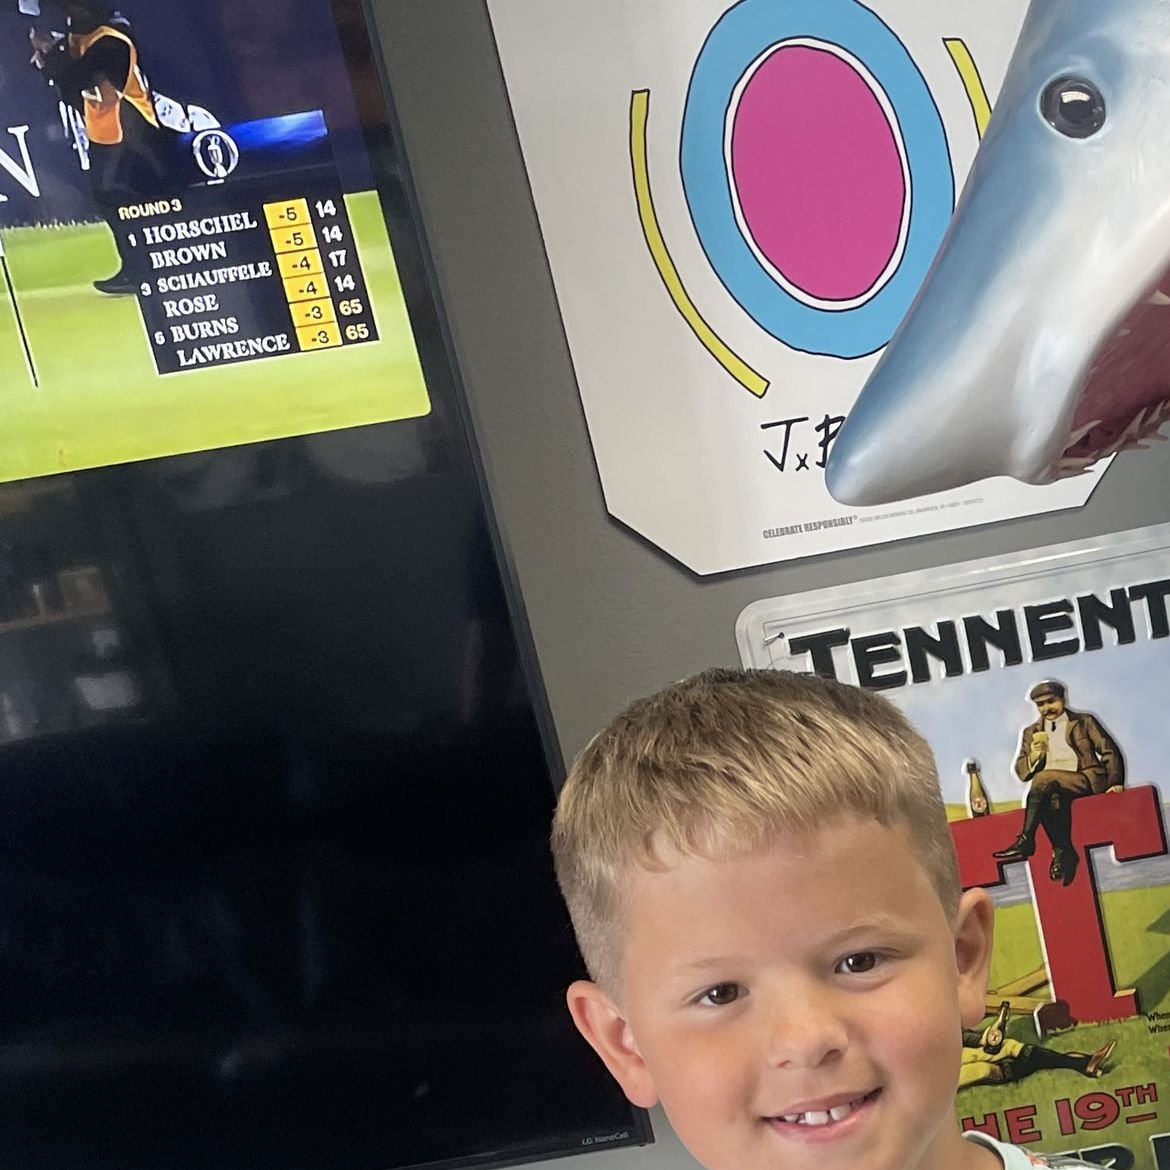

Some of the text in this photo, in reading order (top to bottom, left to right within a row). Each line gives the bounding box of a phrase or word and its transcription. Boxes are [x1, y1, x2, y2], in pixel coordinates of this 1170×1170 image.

[118, 199, 182, 220] ROUND 3
[128, 199, 337, 247] 1 HORSCHEL -5 14
[149, 225, 343, 269] BROWN -5 14
[140, 249, 347, 296] 3 SCHAUFFELE -4 17
[163, 274, 356, 318] ROSE -4 14
[170, 317, 239, 343] BURNS
[305, 306, 323, 320] -3
[339, 298, 363, 316] 65
[176, 323, 369, 367] LAWRENCE -3 65
[762, 524, 804, 540] CELEBRATE
[1147, 1011, 1170, 1022] When
[961, 1104, 1043, 1144] HE
